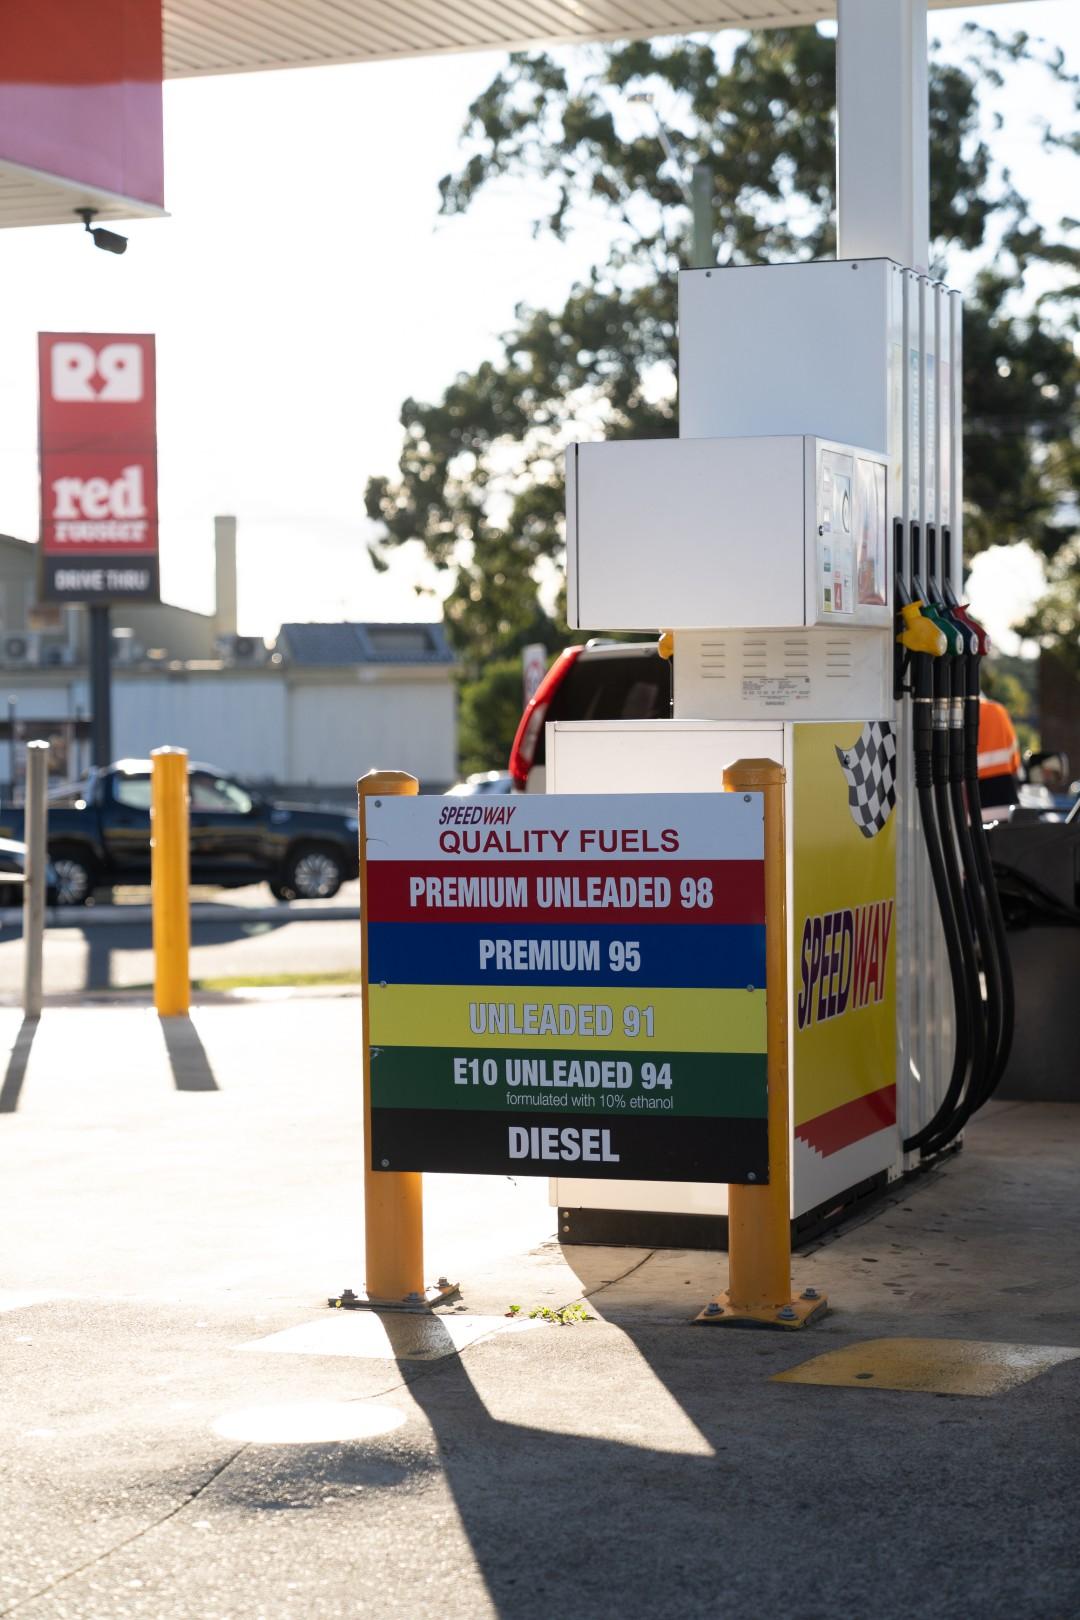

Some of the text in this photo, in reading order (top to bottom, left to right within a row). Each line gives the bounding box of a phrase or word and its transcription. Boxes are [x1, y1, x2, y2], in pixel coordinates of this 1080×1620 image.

[53, 464, 146, 520] red
[438, 806, 517, 826] SPEEDWAY
[439, 828, 680, 855] QUALITY FUELS
[409, 876, 714, 909] PREMIUM UNLEADED 98
[479, 939, 641, 972] PREMIUM 95
[797, 899, 893, 1030] SPEEDWAY
[469, 1002, 655, 1037] UNLEADED 91
[453, 1057, 673, 1090] E10 UNLEADED 94
[506, 1092, 674, 1110] formulated with 10% ethanol
[508, 1126, 620, 1163] DIESEL
